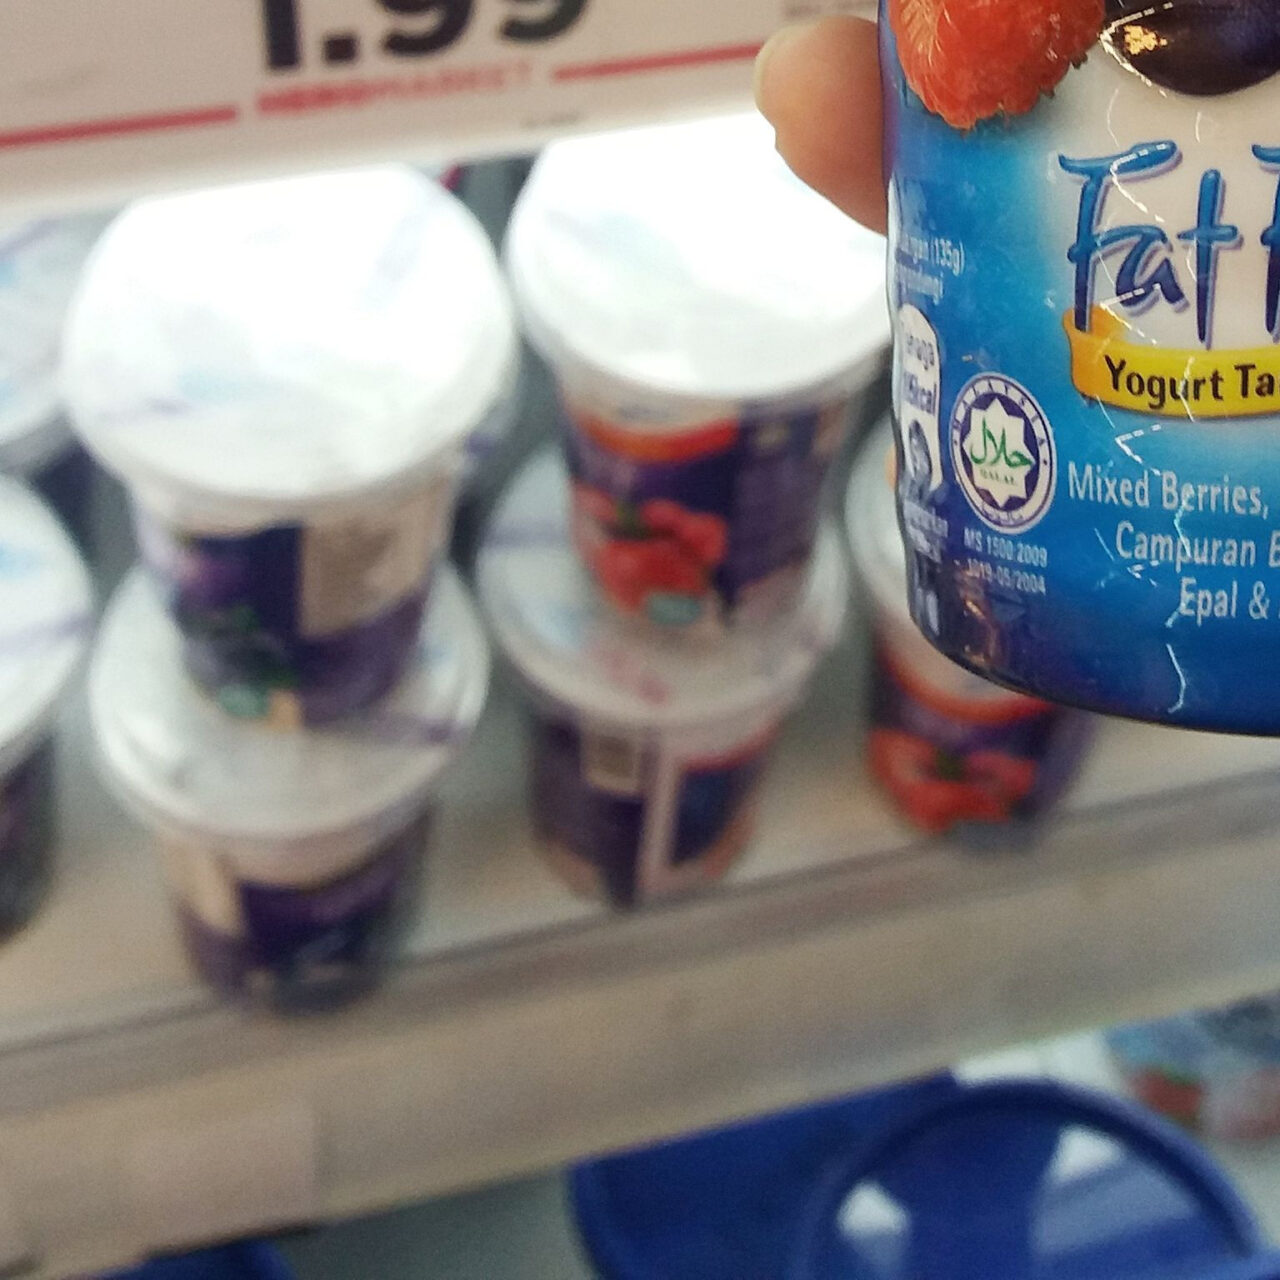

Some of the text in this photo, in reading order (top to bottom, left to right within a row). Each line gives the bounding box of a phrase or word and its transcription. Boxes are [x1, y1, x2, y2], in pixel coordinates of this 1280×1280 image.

[1058, 139, 1243, 349] Fat
[1104, 354, 1224, 409] Yogurt
[1068, 461, 1149, 508] Mixed
[1162, 470, 1269, 520] Berries,
[1115, 521, 1256, 574] Campuran
[1180, 576, 1238, 627] Epal
[1248, 581, 1269, 620] &
